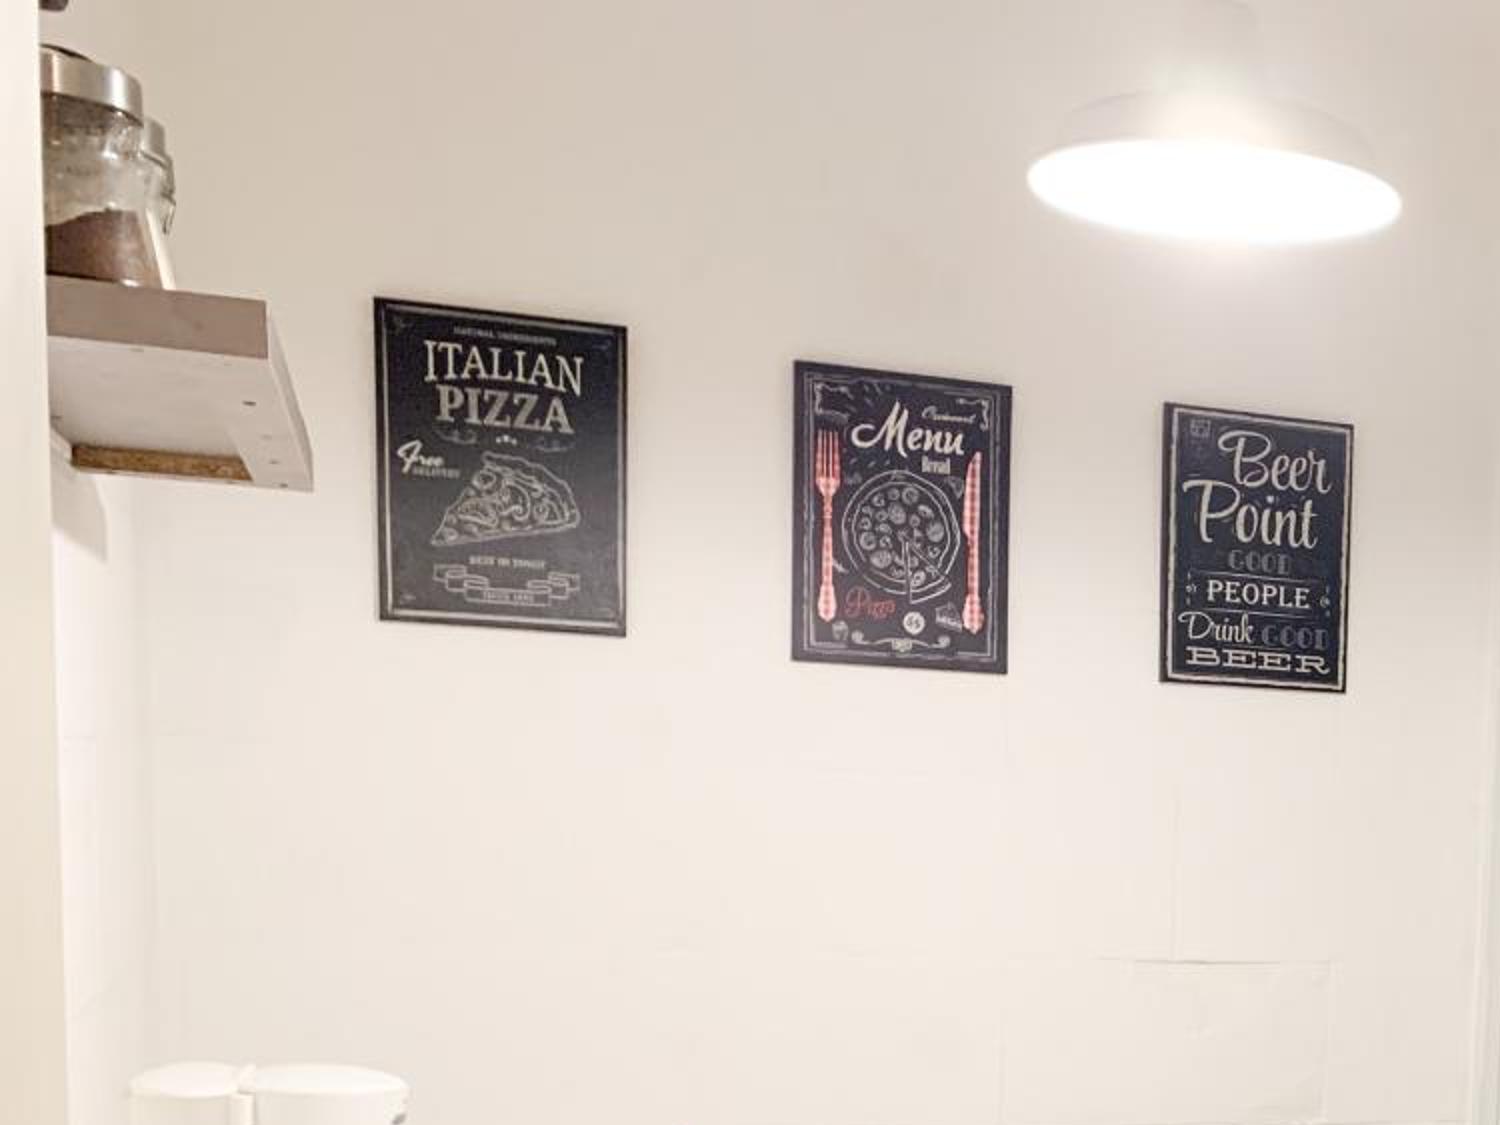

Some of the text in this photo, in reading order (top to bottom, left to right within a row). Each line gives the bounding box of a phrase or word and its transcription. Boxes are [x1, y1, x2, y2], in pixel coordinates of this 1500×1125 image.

[423, 339, 584, 397] ITALIAN
[436, 383, 575, 434] PIZZA
[851, 400, 965, 458] Menu
[1218, 430, 1332, 494] Beer
[1182, 478, 1319, 549] Point
[1206, 579, 1311, 609] PEOPLE
[1177, 611, 1254, 644] Drink
[1185, 646, 1331, 675] BEER
